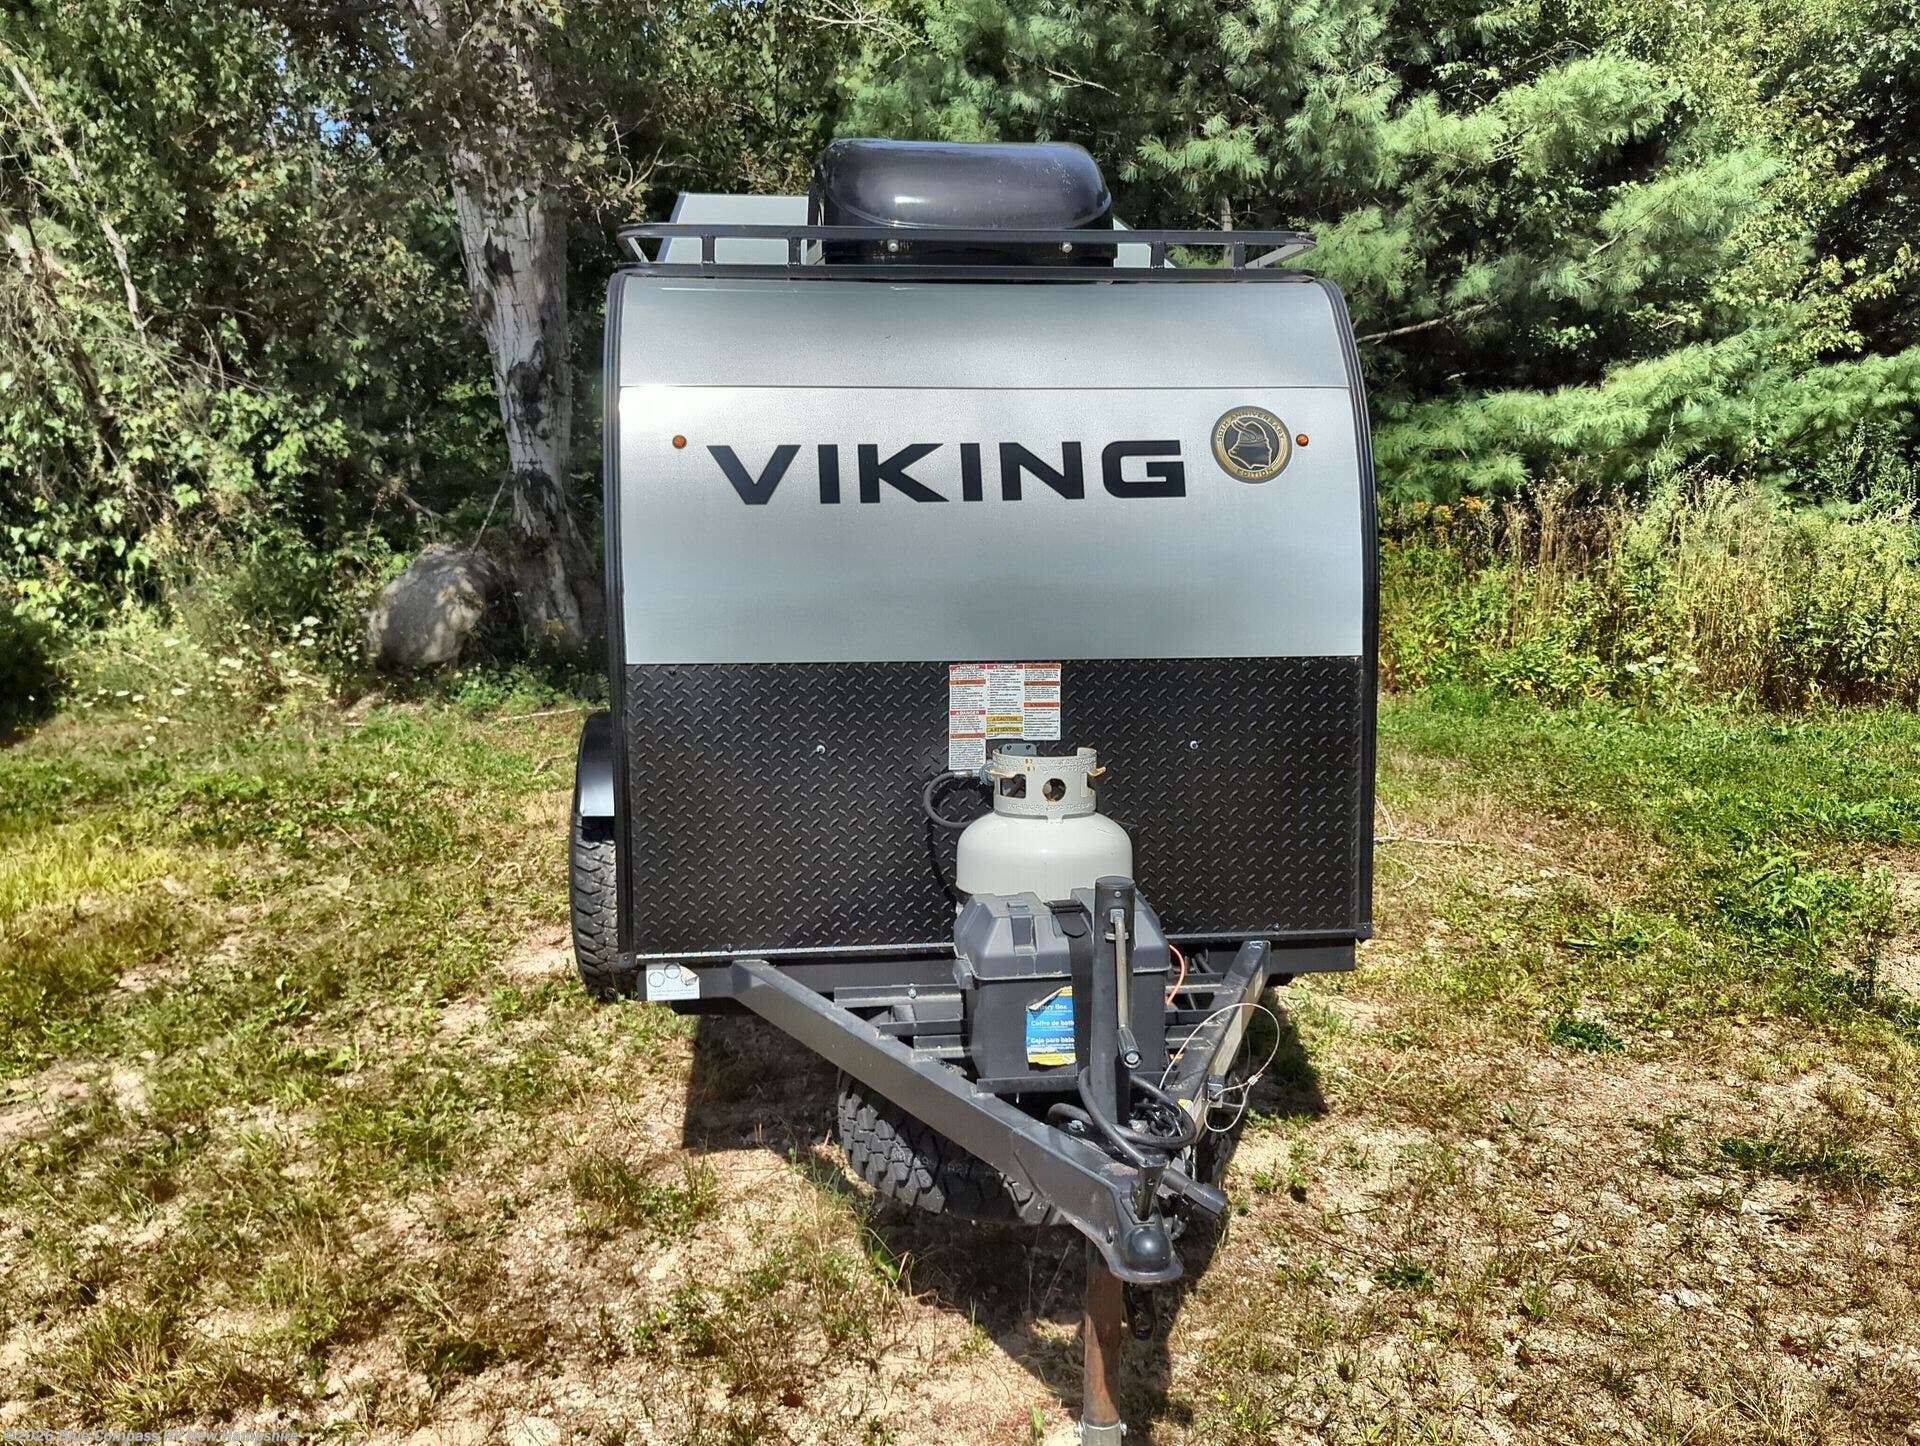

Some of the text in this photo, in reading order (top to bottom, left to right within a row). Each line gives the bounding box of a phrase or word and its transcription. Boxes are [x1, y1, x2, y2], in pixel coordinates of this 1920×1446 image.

[1230, 411, 1286, 440] ANNIVERSARY
[706, 439, 1186, 505] VIKING
[1236, 467, 1275, 478] EDITION
